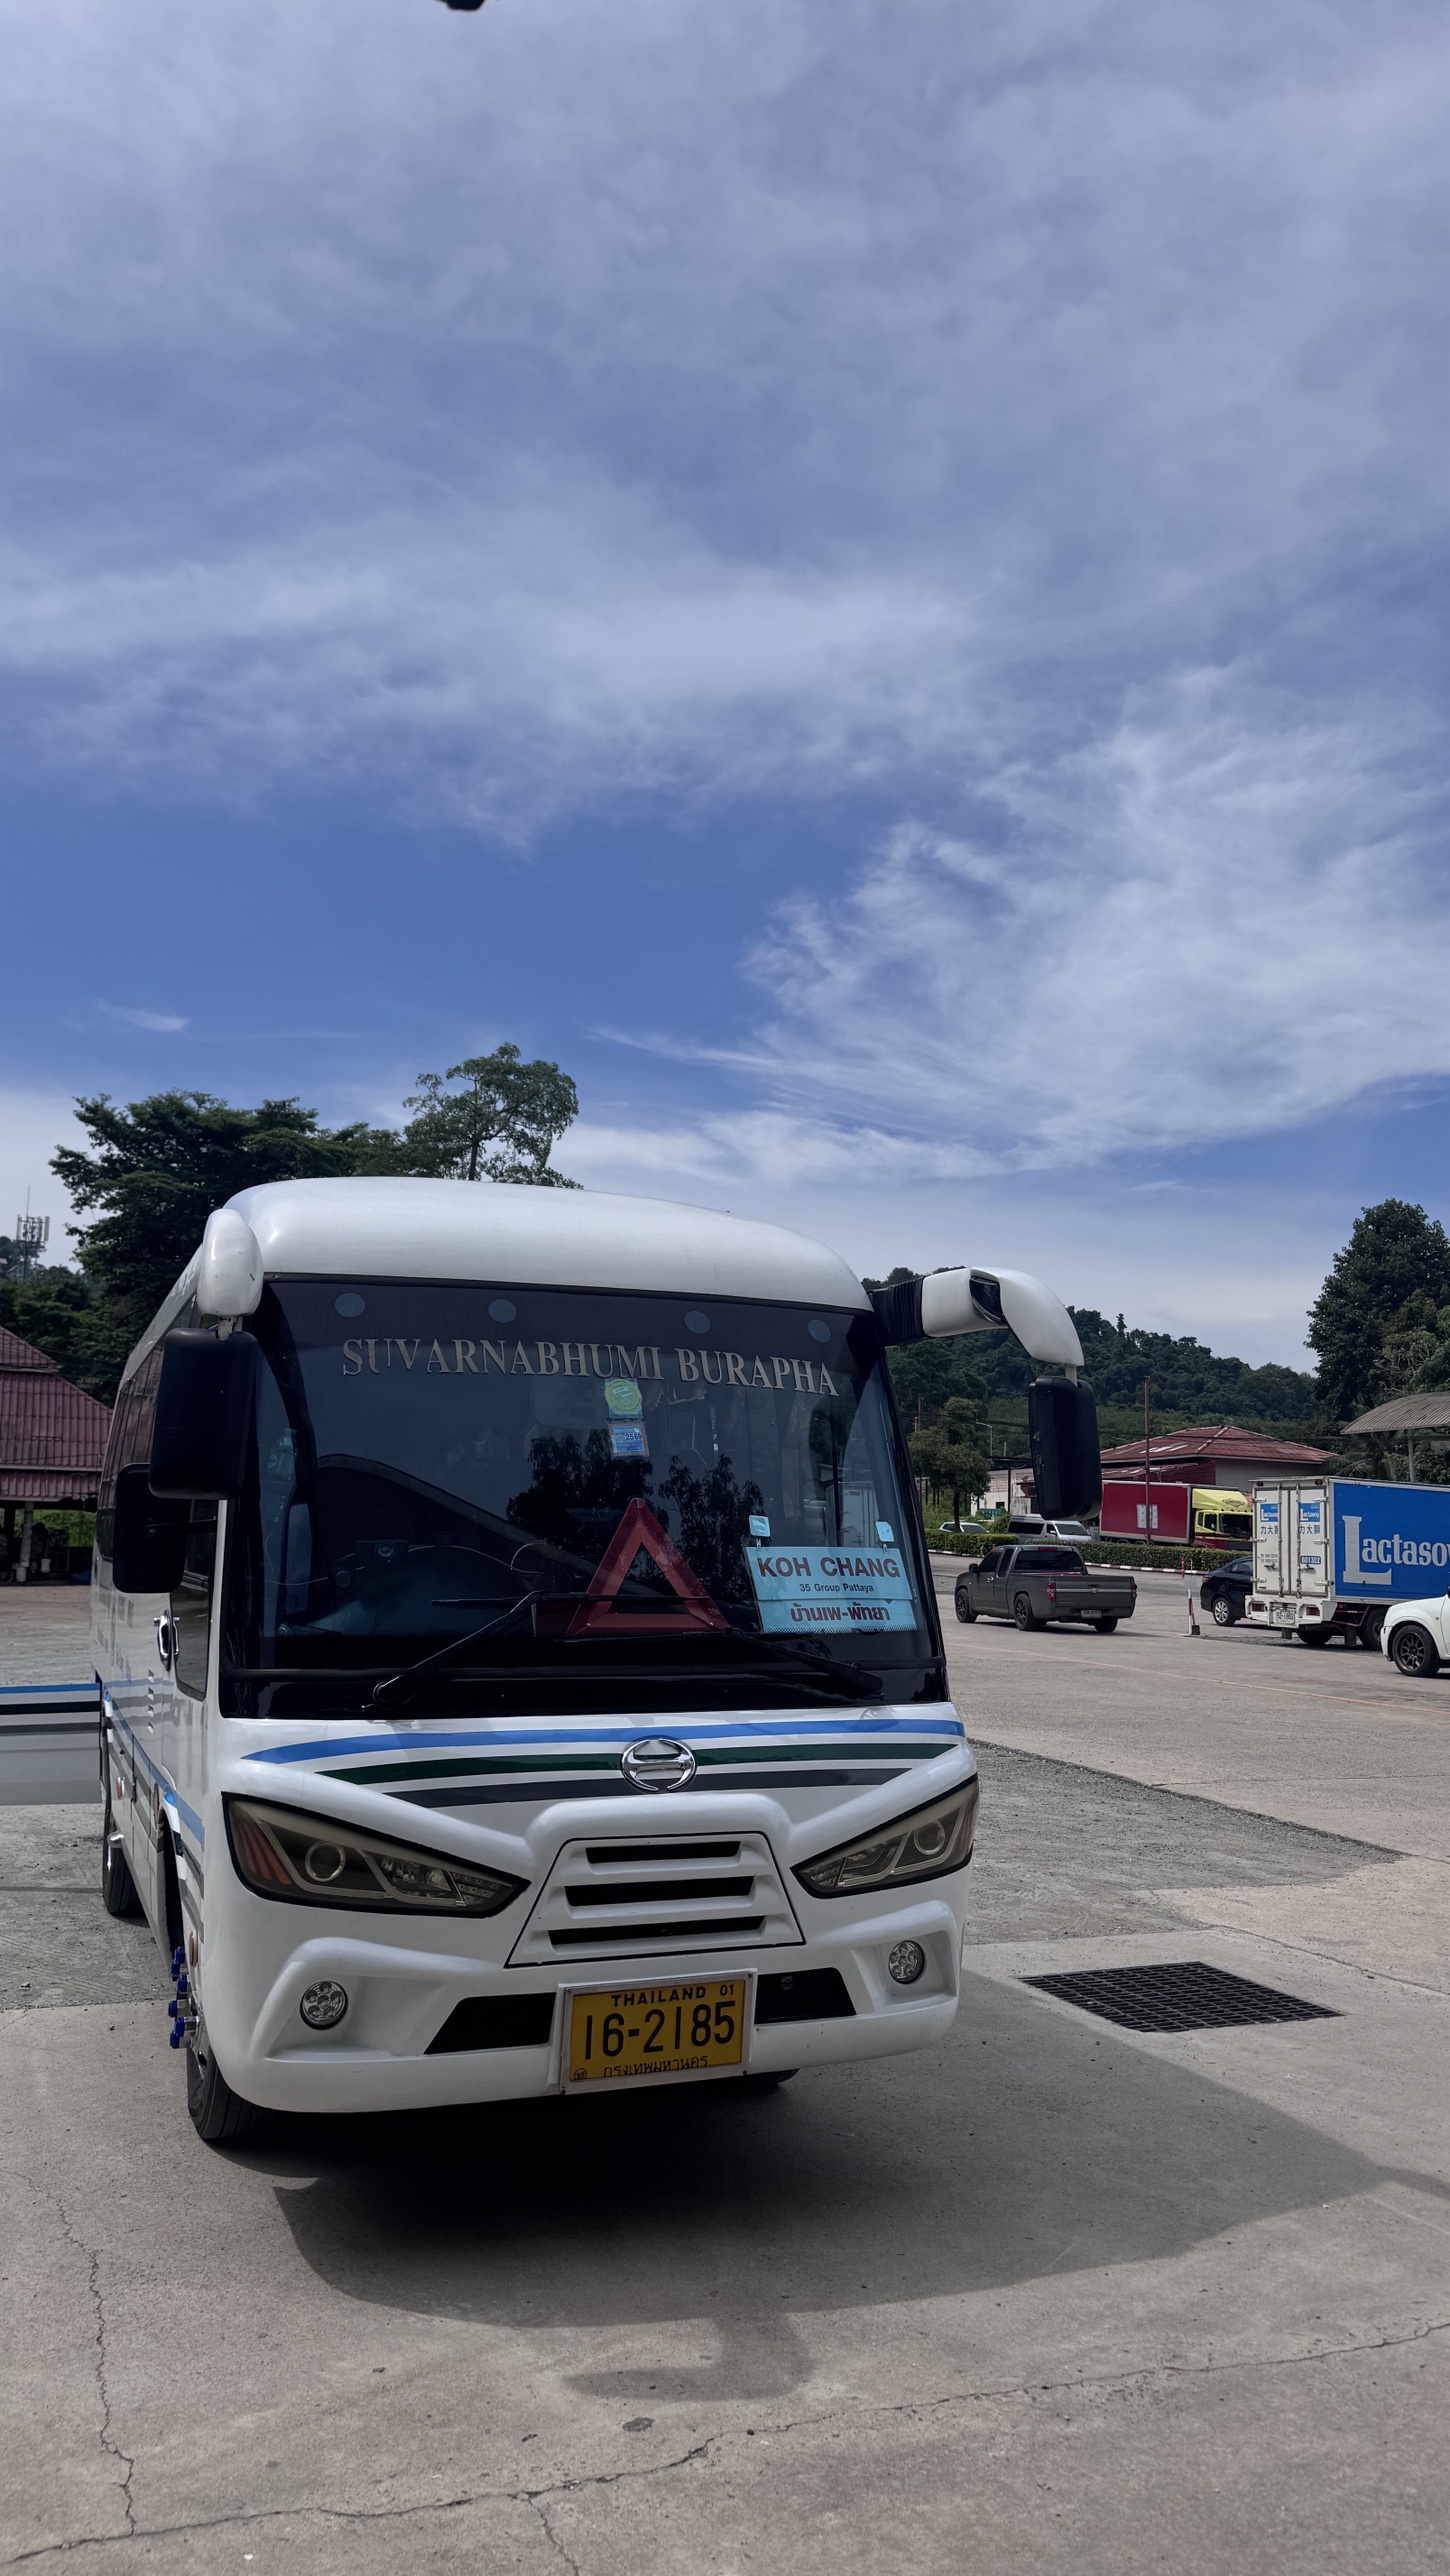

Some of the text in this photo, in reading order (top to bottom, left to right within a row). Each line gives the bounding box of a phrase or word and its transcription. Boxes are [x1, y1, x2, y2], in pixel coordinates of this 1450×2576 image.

[342, 1338, 665, 1380] SUVARNABHUMI
[674, 1347, 840, 1397] BURAPHA
[1342, 1515, 1450, 1586] Lactaso
[756, 1557, 901, 1578] KOH CHANG
[814, 1583, 840, 1593] Group
[842, 1582, 874, 1593] Pattaya
[790, 1601, 891, 1622] บ้านเพ-พัทยา
[611, 1984, 734, 2007] THAILAND 01
[585, 2000, 736, 2060] 16-2185
[603, 2056, 708, 2078] กรงเทพมหานคร
